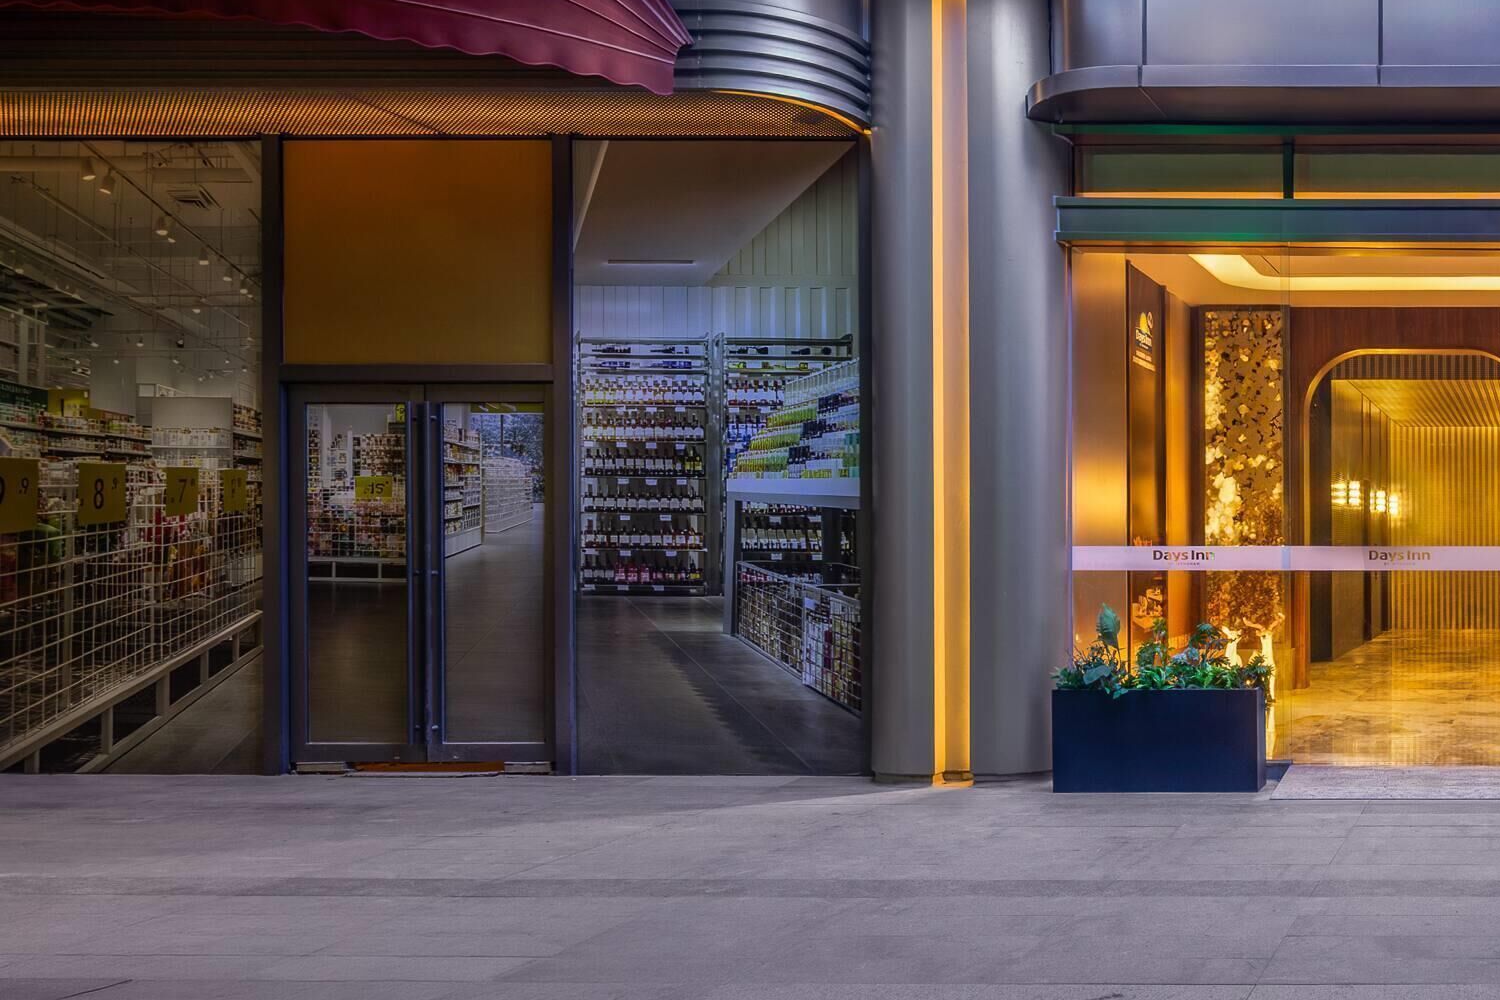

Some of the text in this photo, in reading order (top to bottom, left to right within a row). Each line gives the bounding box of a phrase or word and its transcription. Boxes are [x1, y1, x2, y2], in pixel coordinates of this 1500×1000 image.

[1153, 550, 1215, 562] Days Inn
[1369, 550, 1431, 562] Days Inn
